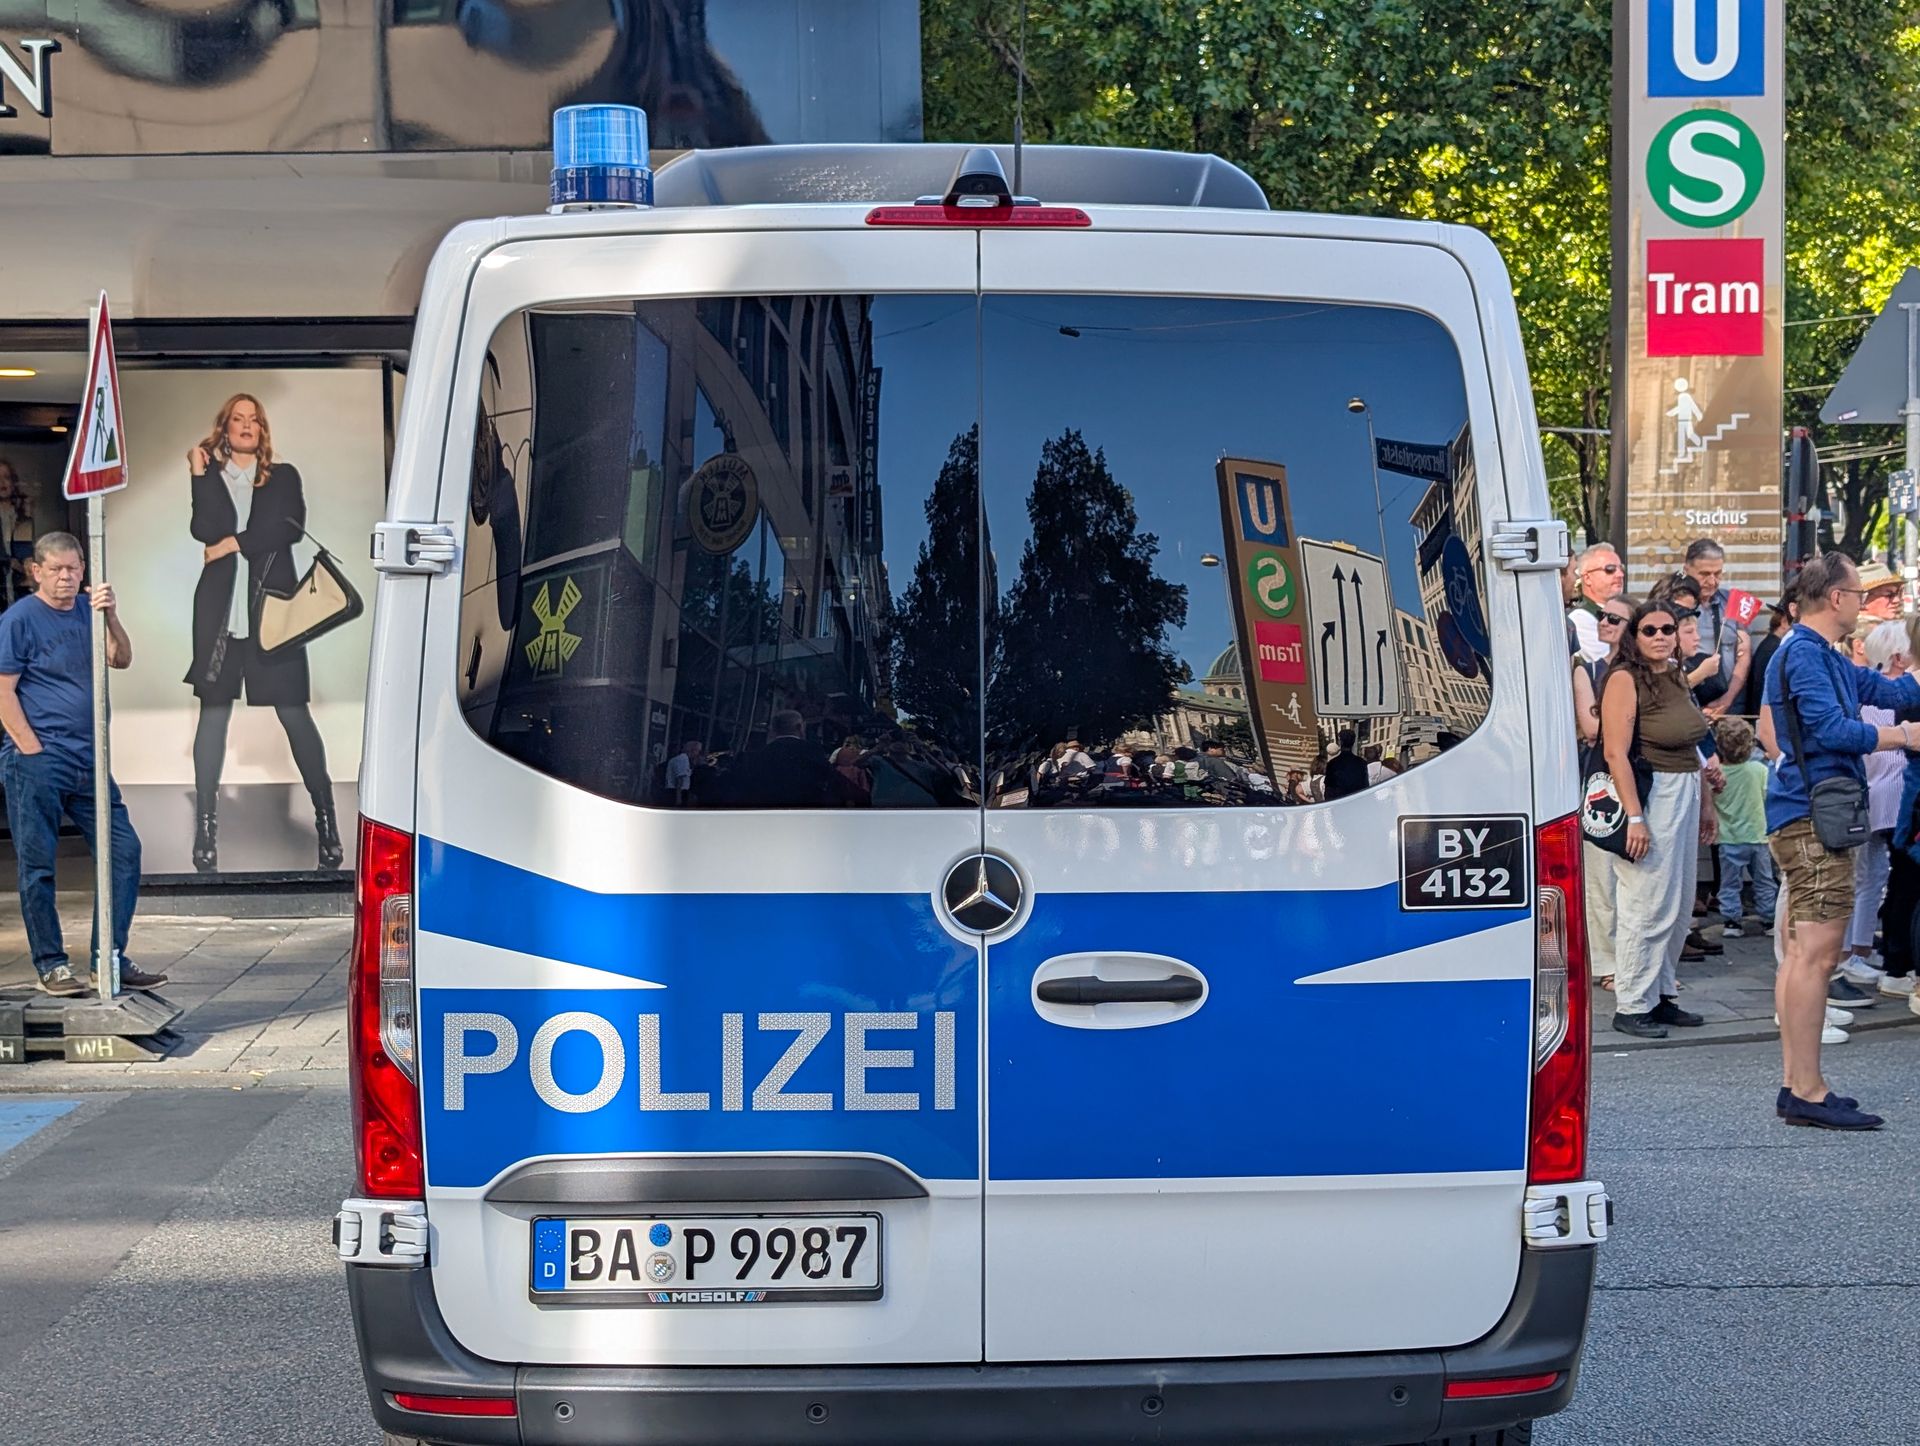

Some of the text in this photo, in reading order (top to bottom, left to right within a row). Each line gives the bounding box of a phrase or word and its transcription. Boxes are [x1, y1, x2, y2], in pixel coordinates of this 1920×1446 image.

[1673, 0, 1740, 82] U
[1668, 119, 1747, 217] S
[1647, 273, 1761, 315] Tram
[1685, 507, 1748, 525] Stachus
[1438, 828, 1490, 858] BY
[1420, 867, 1511, 898] 4132
[75, 1038, 113, 1057] WH
[443, 1011, 956, 1114] POLIZEI
[570, 1228, 641, 1281] BA
[683, 1228, 716, 1280] P
[730, 1226, 868, 1280] 9987
[544, 1263, 556, 1278] D
[672, 1291, 746, 1303] MOSOLF
